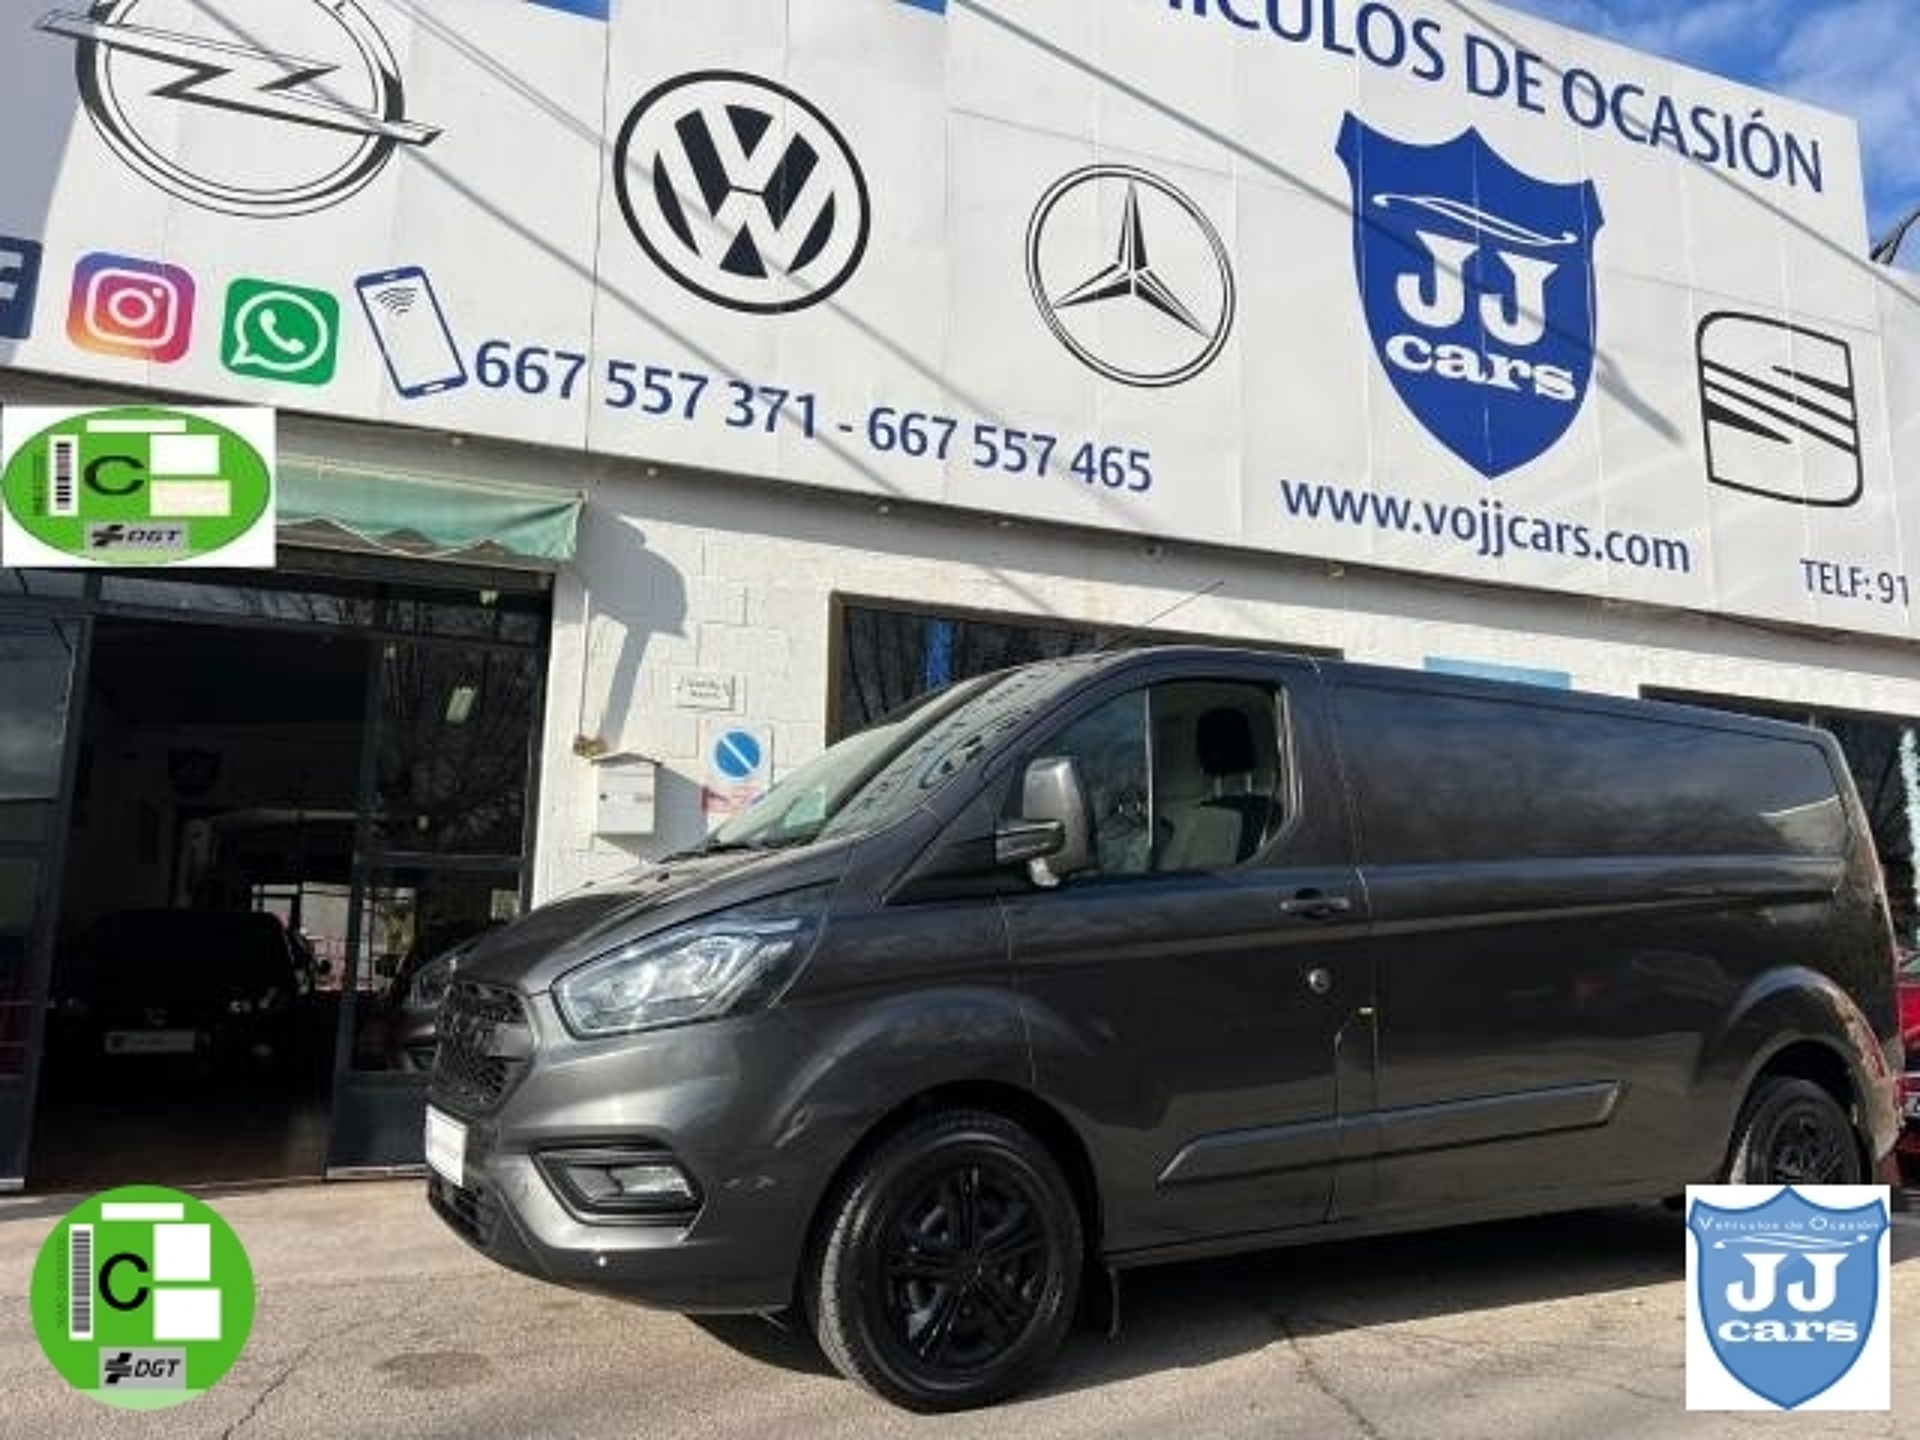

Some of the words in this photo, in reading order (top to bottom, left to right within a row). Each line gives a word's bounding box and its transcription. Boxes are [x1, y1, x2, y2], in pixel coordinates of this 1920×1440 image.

[1166, 0, 1446, 81] ULOS
[1465, 35, 1546, 115] DE
[1562, 66, 1824, 194] OCASIÓN
[1396, 229, 1560, 346] JJ
[475, 340, 586, 400] 667
[605, 359, 709, 420] 557
[725, 379, 816, 439] 371
[868, 407, 957, 460] 667
[973, 424, 1057, 478] 557
[1070, 442, 1152, 492] 465
[1385, 334, 1577, 401] cars
[1281, 479, 1691, 573] www.vojjcars.com
[1799, 558, 1873, 601] TELF:
[1877, 571, 1909, 607] 91
